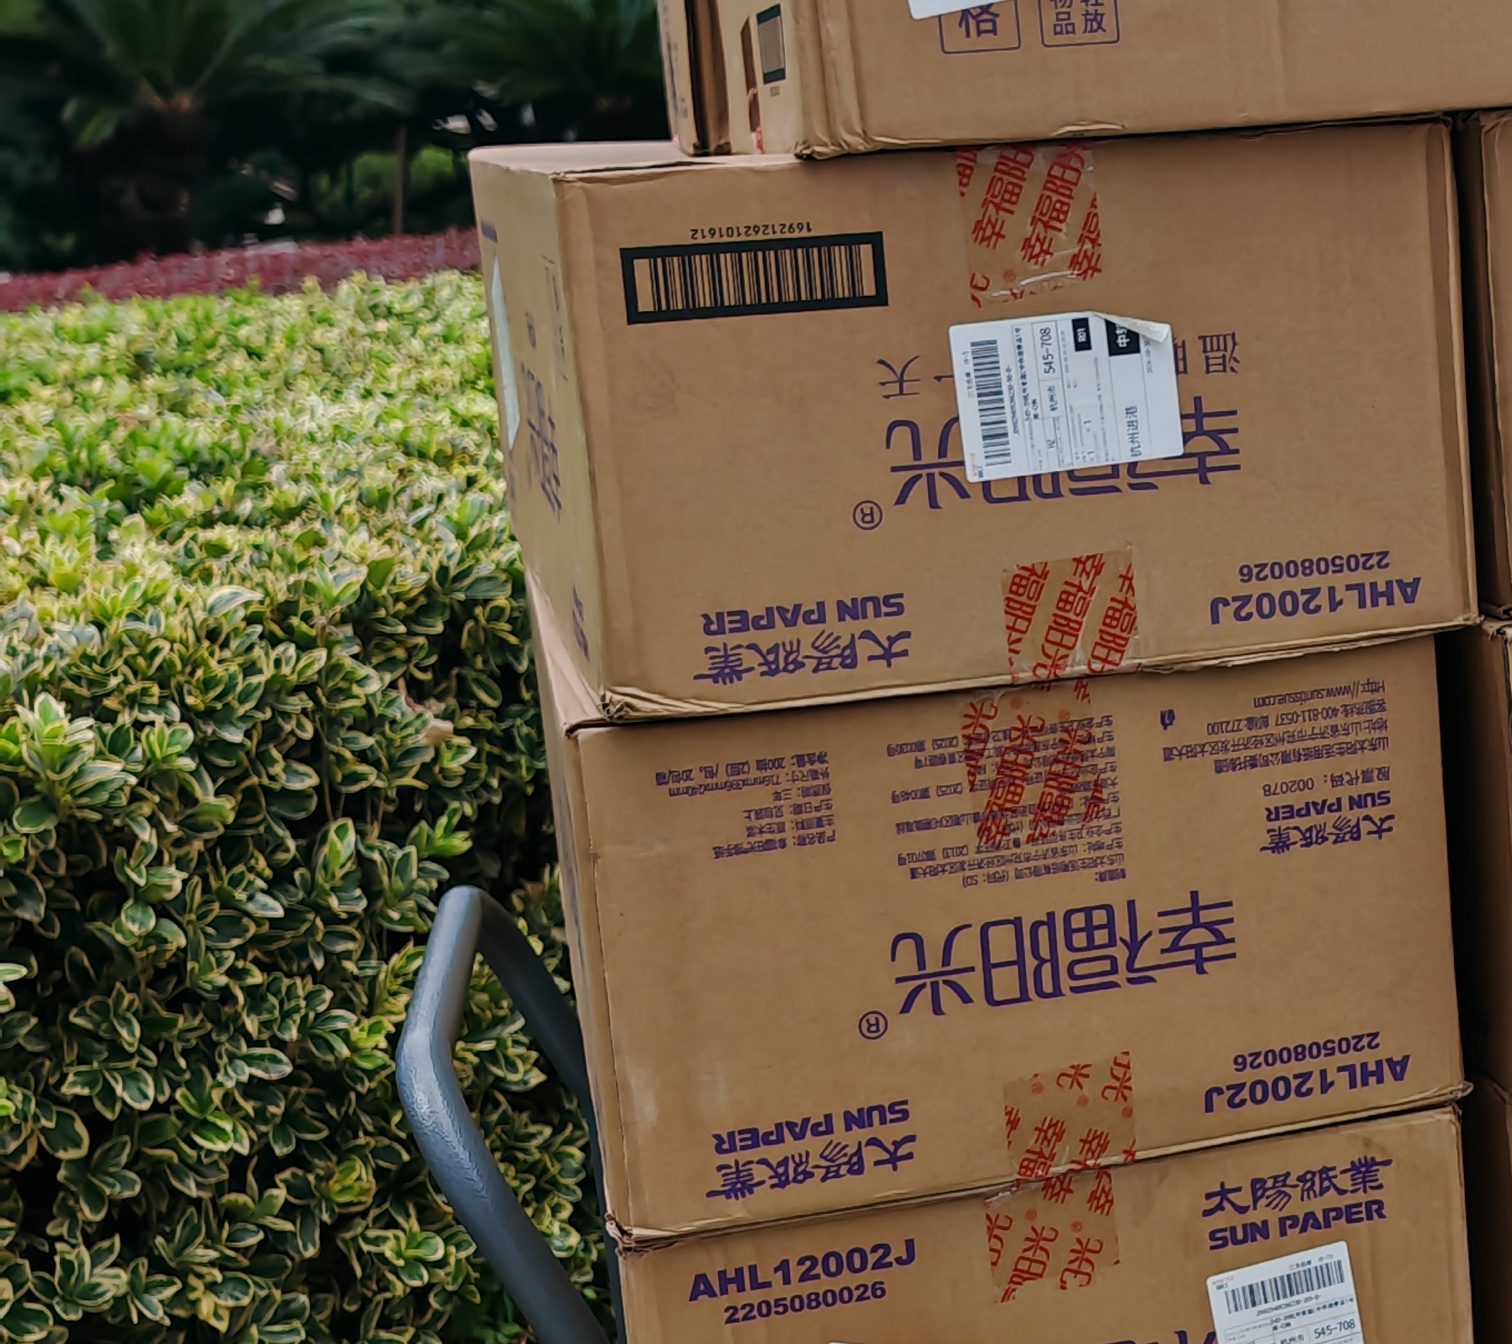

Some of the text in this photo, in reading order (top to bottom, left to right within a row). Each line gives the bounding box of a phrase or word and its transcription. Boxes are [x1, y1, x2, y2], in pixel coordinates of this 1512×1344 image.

[689, 221, 813, 241] 16921262101612
[1039, 326, 1056, 375] 545-708
[1123, 405, 1143, 458] 杭州进港
[1237, 549, 1392, 584] 2205080026
[701, 593, 906, 637] SUN PAPER
[1208, 576, 1422, 627] AHL12002J
[692, 629, 914, 687] 太陽紙業
[1260, 805, 1394, 853] 太陽紙業
[1265, 793, 1391, 820] SUN PAPER
[890, 892, 1235, 1016] 幸福阳光
[1232, 1032, 1380, 1071] 2205080026
[1204, 1057, 1409, 1115] AHL12002J
[712, 1100, 910, 1154] SUN PAPER
[706, 1135, 916, 1199] 太陽紙業
[1202, 1158, 1392, 1217] 太陽紙業
[1208, 1200, 1385, 1250] SUN PAPER
[689, 1238, 916, 1299] AHL12002J
[724, 1282, 886, 1325] 2205080026
[1313, 1318, 1356, 1339] 545-708
